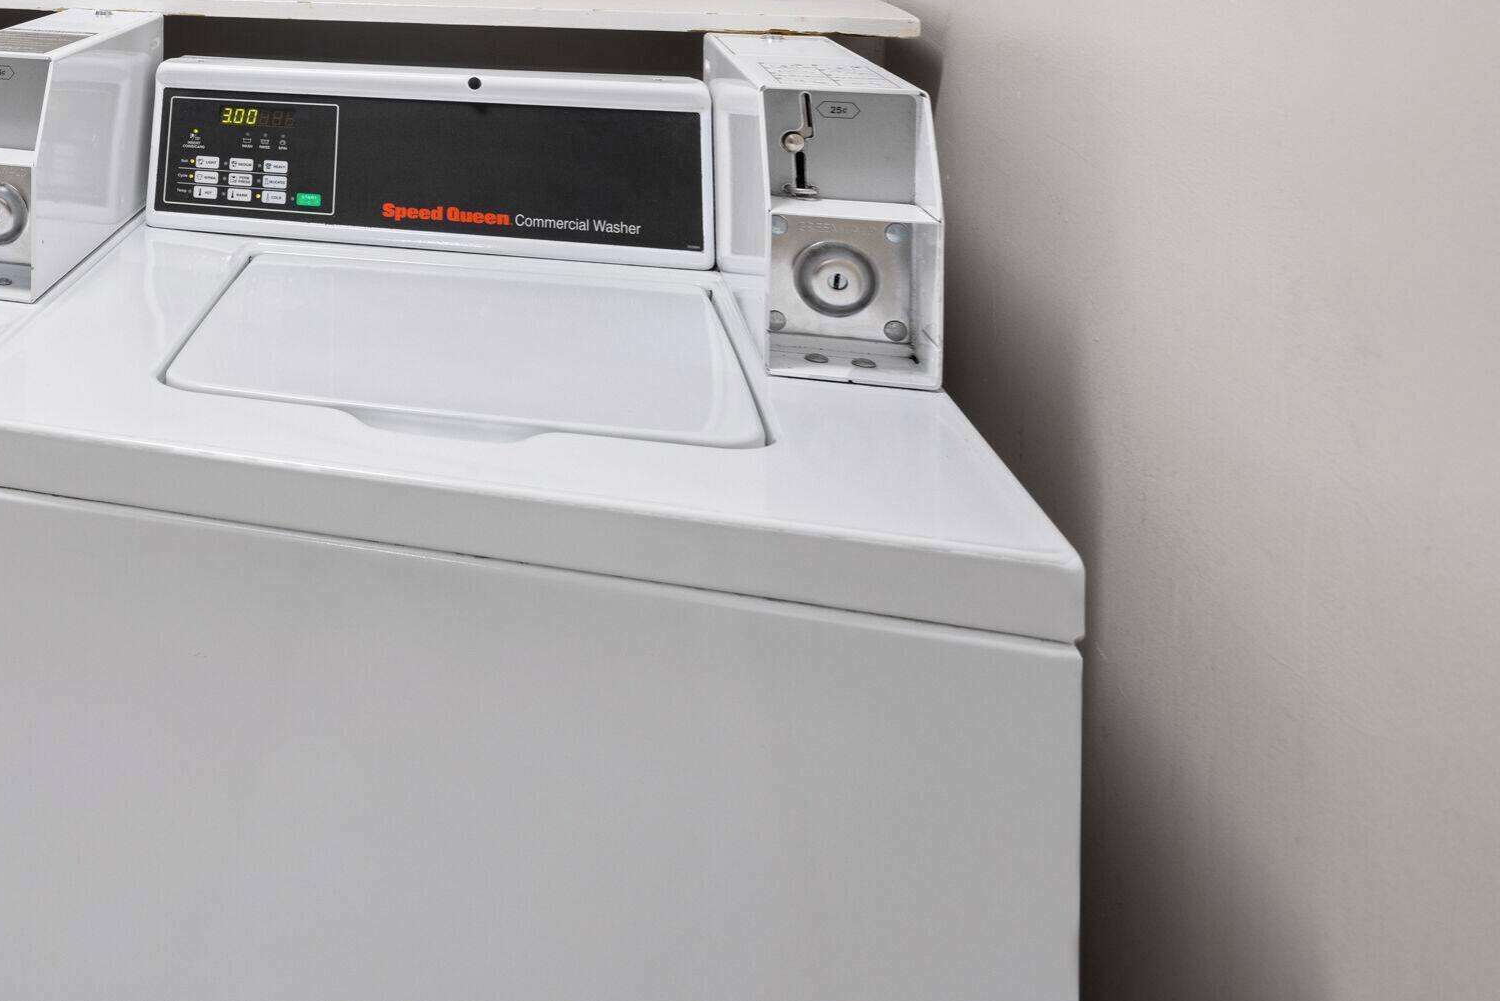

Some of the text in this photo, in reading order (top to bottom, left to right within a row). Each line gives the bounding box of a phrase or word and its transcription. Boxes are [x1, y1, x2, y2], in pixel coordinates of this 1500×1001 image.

[221, 107, 258, 125] 3.00
[381, 202, 642, 236] Speed Queen Commercial Washer
